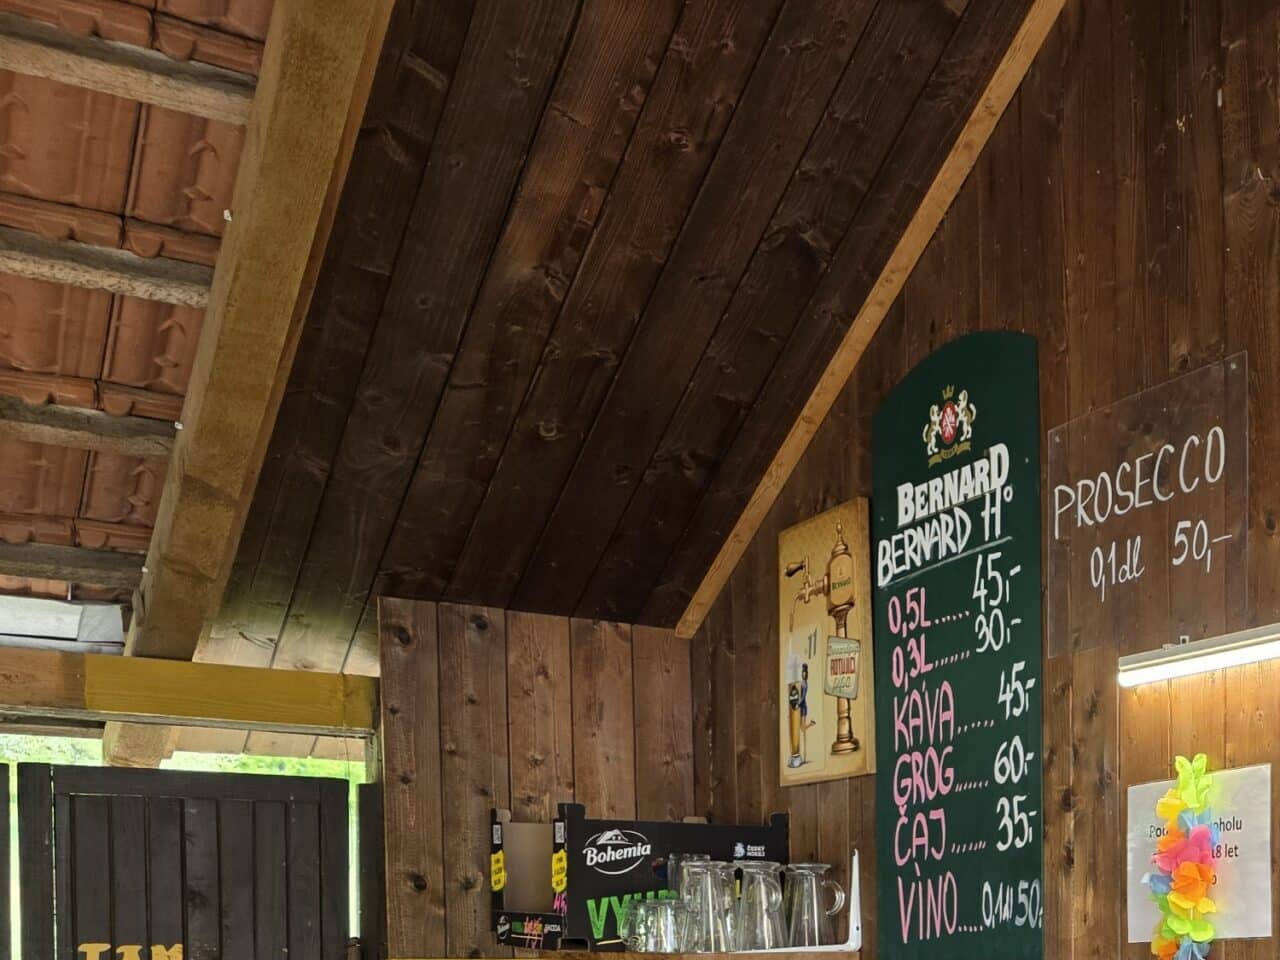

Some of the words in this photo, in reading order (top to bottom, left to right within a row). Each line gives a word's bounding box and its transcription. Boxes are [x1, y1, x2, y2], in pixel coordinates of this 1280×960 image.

[897, 443, 1010, 528] BERNARD
[1054, 426, 1225, 539] PROSECCO
[878, 506, 971, 588] BERNARD
[972, 552, 1021, 612] 45,-
[1089, 535, 1144, 601] 0,1dl
[1172, 520, 1232, 572] 50,-
[975, 608, 1021, 654] 30,-
[582, 842, 651, 866] Bohemia
[1224, 843, 1239, 858] let
